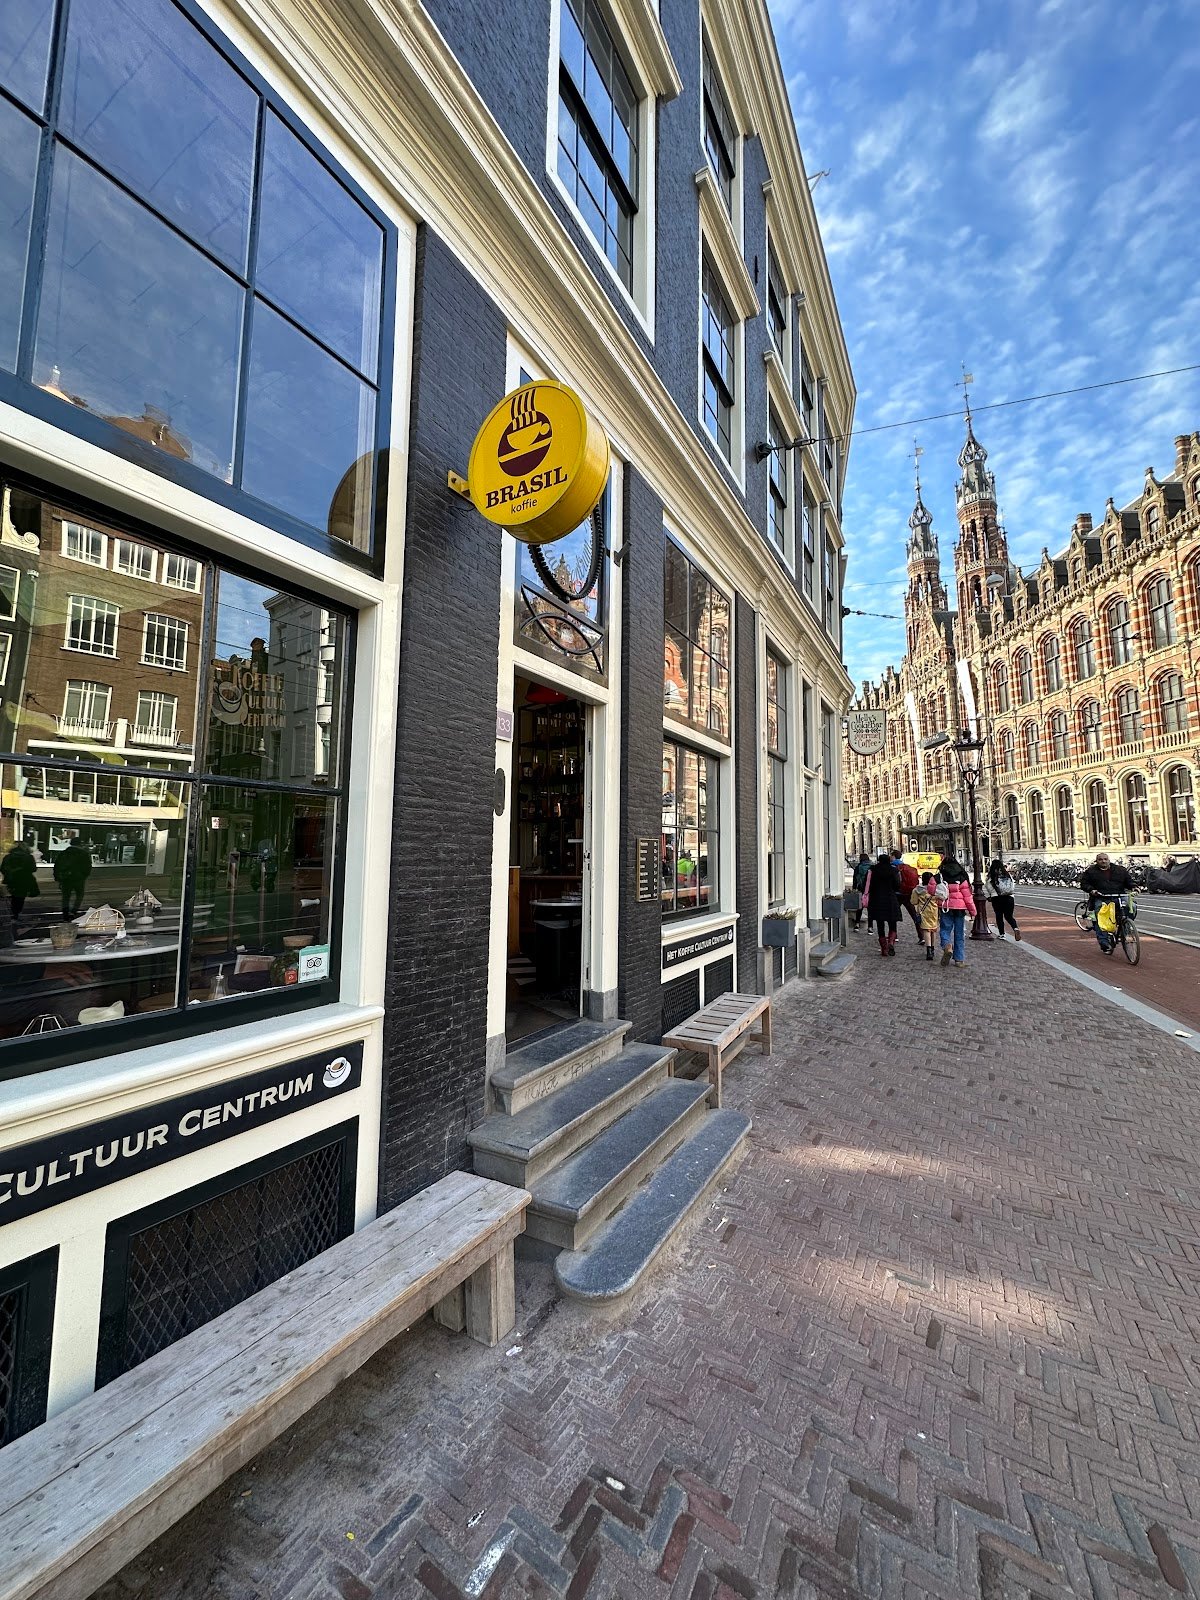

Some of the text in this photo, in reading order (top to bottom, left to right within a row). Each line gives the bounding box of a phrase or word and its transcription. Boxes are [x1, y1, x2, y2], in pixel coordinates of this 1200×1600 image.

[485, 466, 568, 509] BRASIL
[510, 499, 538, 514] koffie
[667, 950, 678, 961] HET
[678, 945, 694, 957] KOFFIE
[0, 1073, 314, 1204] CULTUUR CENTRUM
